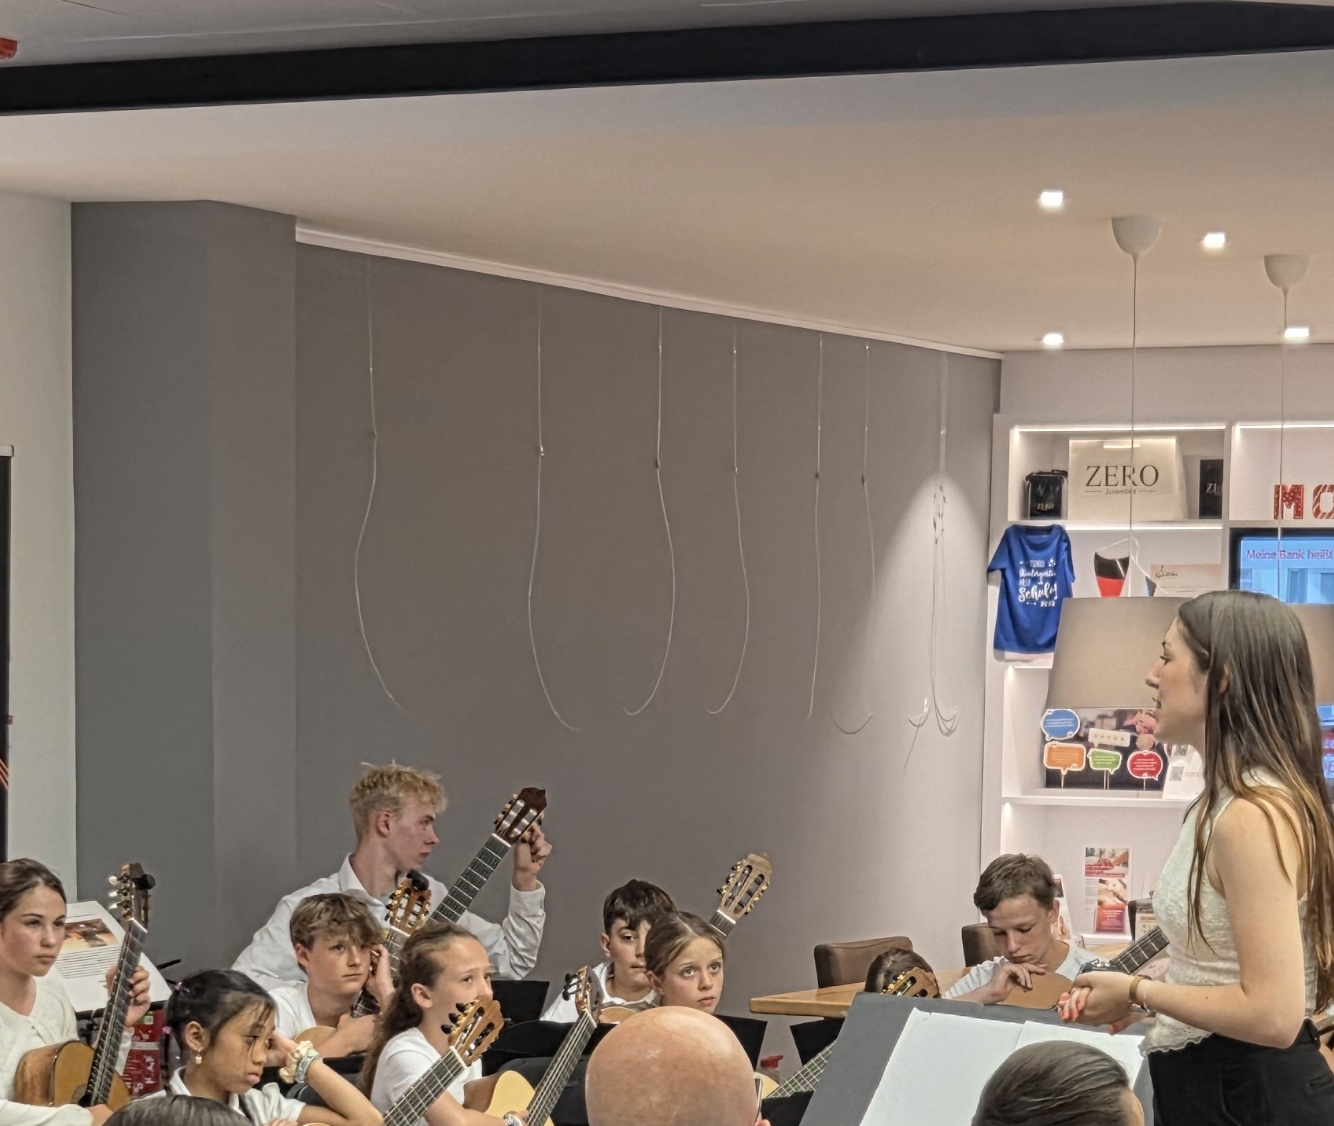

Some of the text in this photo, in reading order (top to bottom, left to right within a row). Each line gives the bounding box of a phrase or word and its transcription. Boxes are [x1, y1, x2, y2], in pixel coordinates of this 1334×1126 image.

[1085, 464, 1159, 487] ZERO
[1247, 549, 1276, 560] Meine
[1279, 549, 1304, 560] Bank
[1308, 549, 1333, 560] heißt
